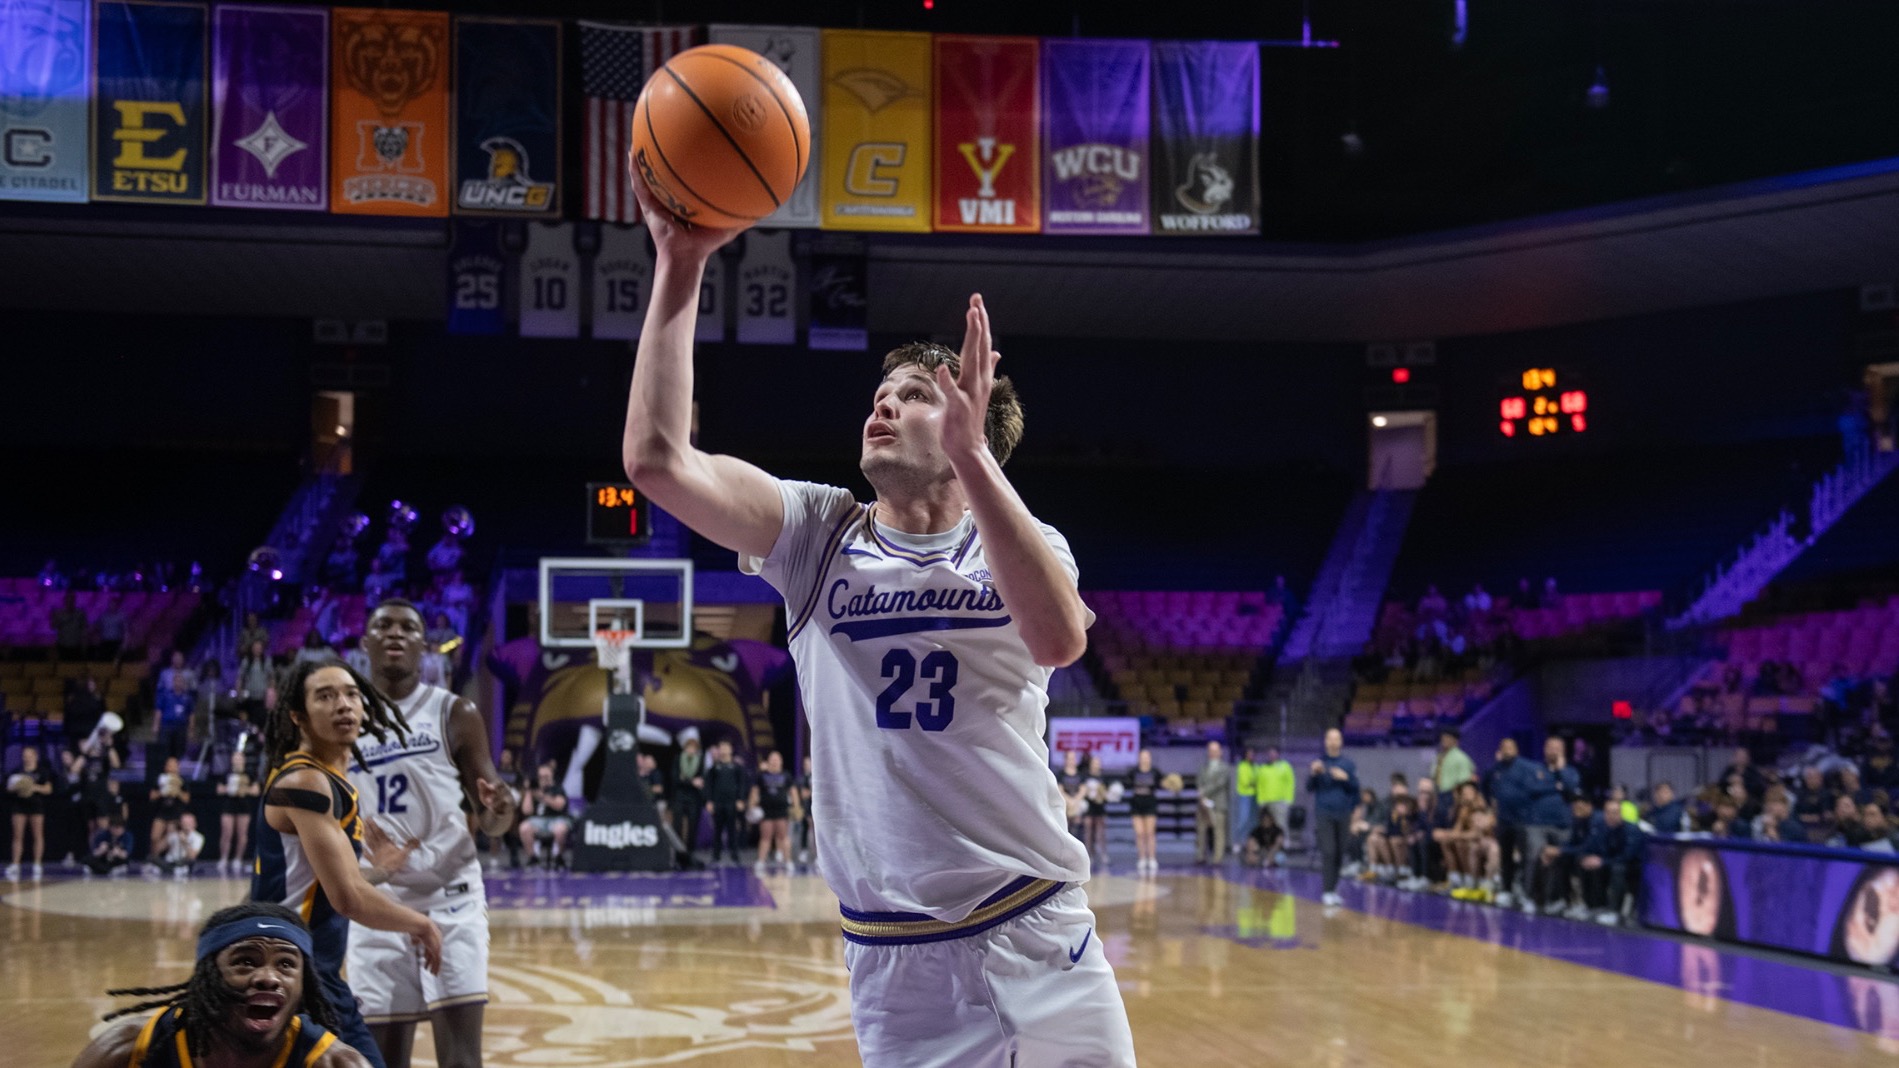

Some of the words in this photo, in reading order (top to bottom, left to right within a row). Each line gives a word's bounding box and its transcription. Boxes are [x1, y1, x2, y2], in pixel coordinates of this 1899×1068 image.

[5, 128, 52, 167] C
[264, 137, 277, 151] F
[846, 142, 906, 196] C
[1053, 145, 1140, 182] WCU
[11, 176, 78, 190] CITADEL
[113, 170, 188, 194] ETSU
[221, 183, 317, 201] FURMAN
[463, 182, 549, 206] UNCG
[958, 199, 1016, 225] VMI
[1160, 213, 1250, 231] WOFFORD
[457, 273, 498, 309] 25
[533, 277, 566, 310] 10
[606, 278, 638, 313] 15
[700, 282, 715, 315] 0
[746, 283, 788, 317] 32
[598, 486, 634, 508] 13.4
[827, 577, 1005, 620] Catamounts
[876, 648, 959, 732] 23
[1056, 731, 1134, 752] ESPN
[375, 773, 409, 814] 12
